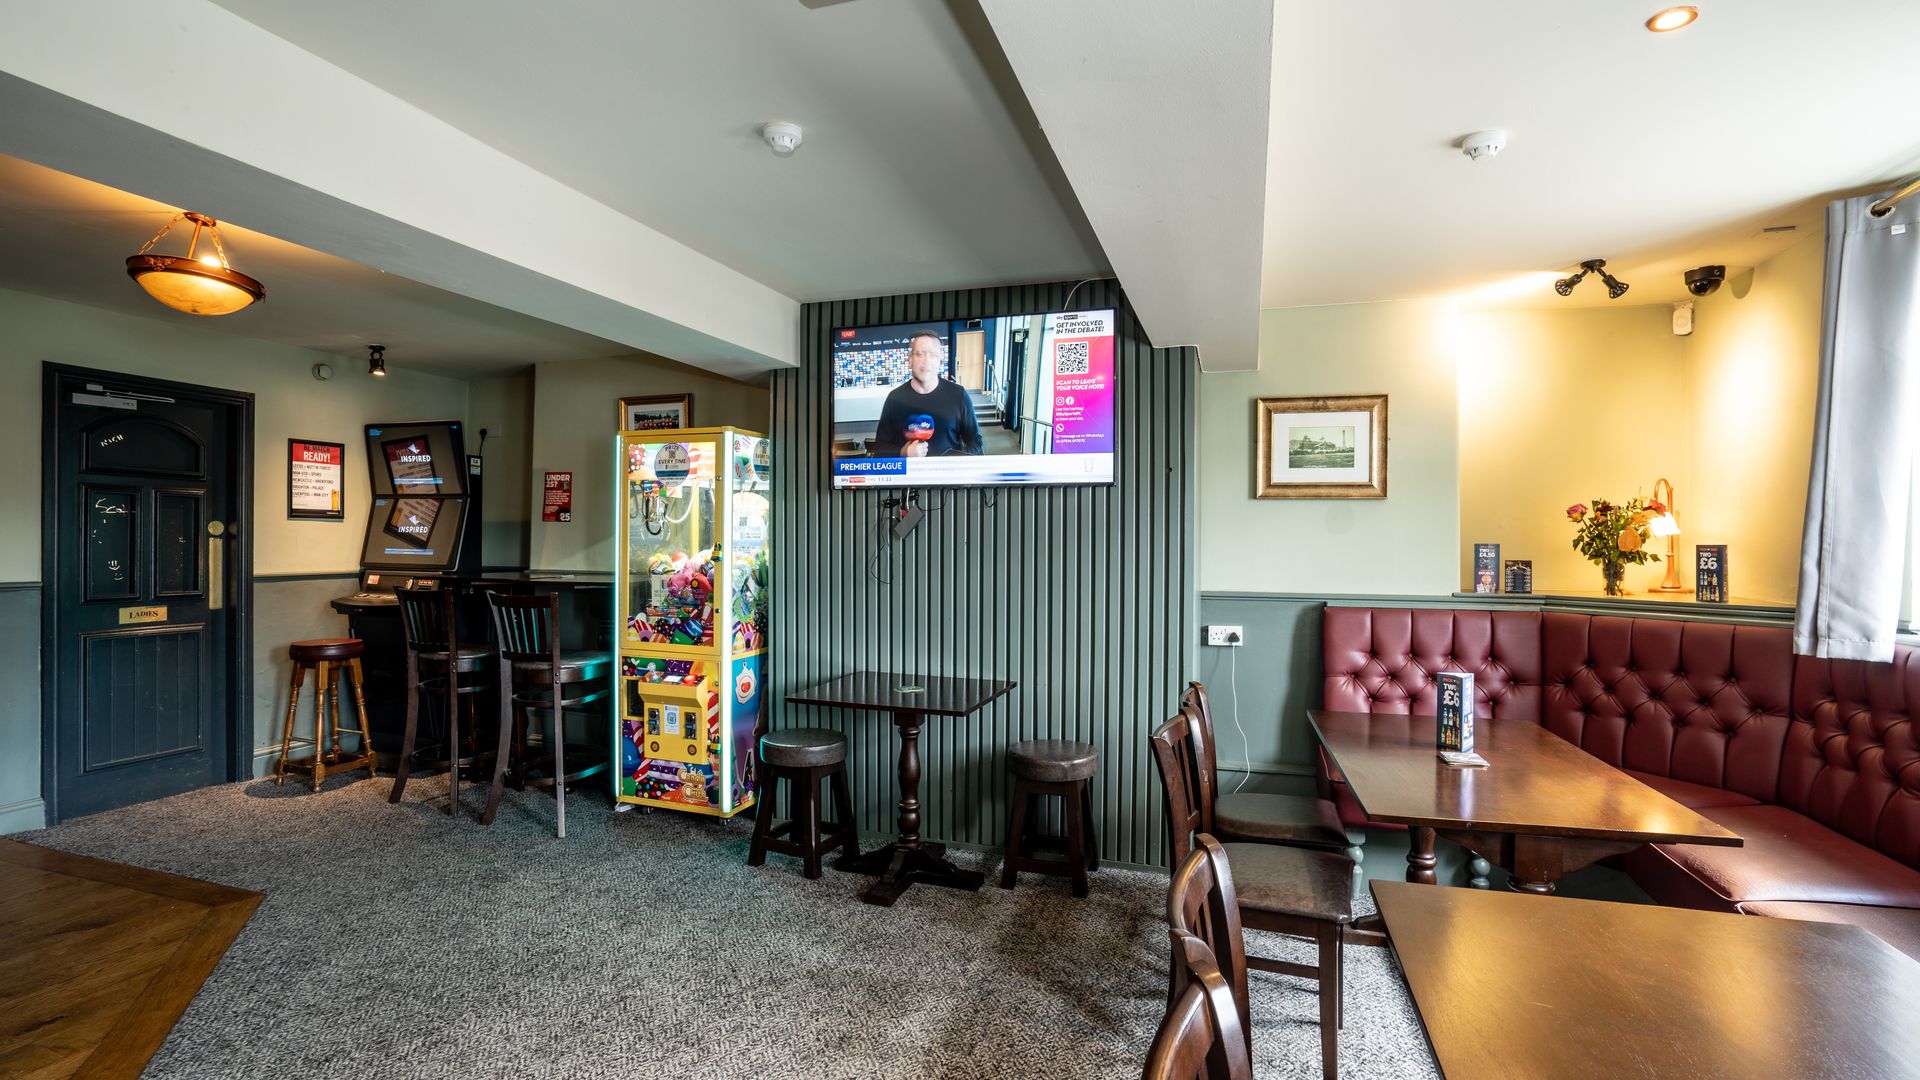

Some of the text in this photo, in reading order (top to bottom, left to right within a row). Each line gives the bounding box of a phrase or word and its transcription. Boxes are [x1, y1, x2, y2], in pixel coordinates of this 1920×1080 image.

[304, 452, 330, 462] READY!
[840, 462, 902, 471] PREMIER LEAGUE
[560, 513, 570, 521] 25
[1700, 557, 1718, 569] £6
[129, 610, 159, 619] LADIES
[1443, 690, 1460, 707] £6
[678, 768, 704, 784] Candy
